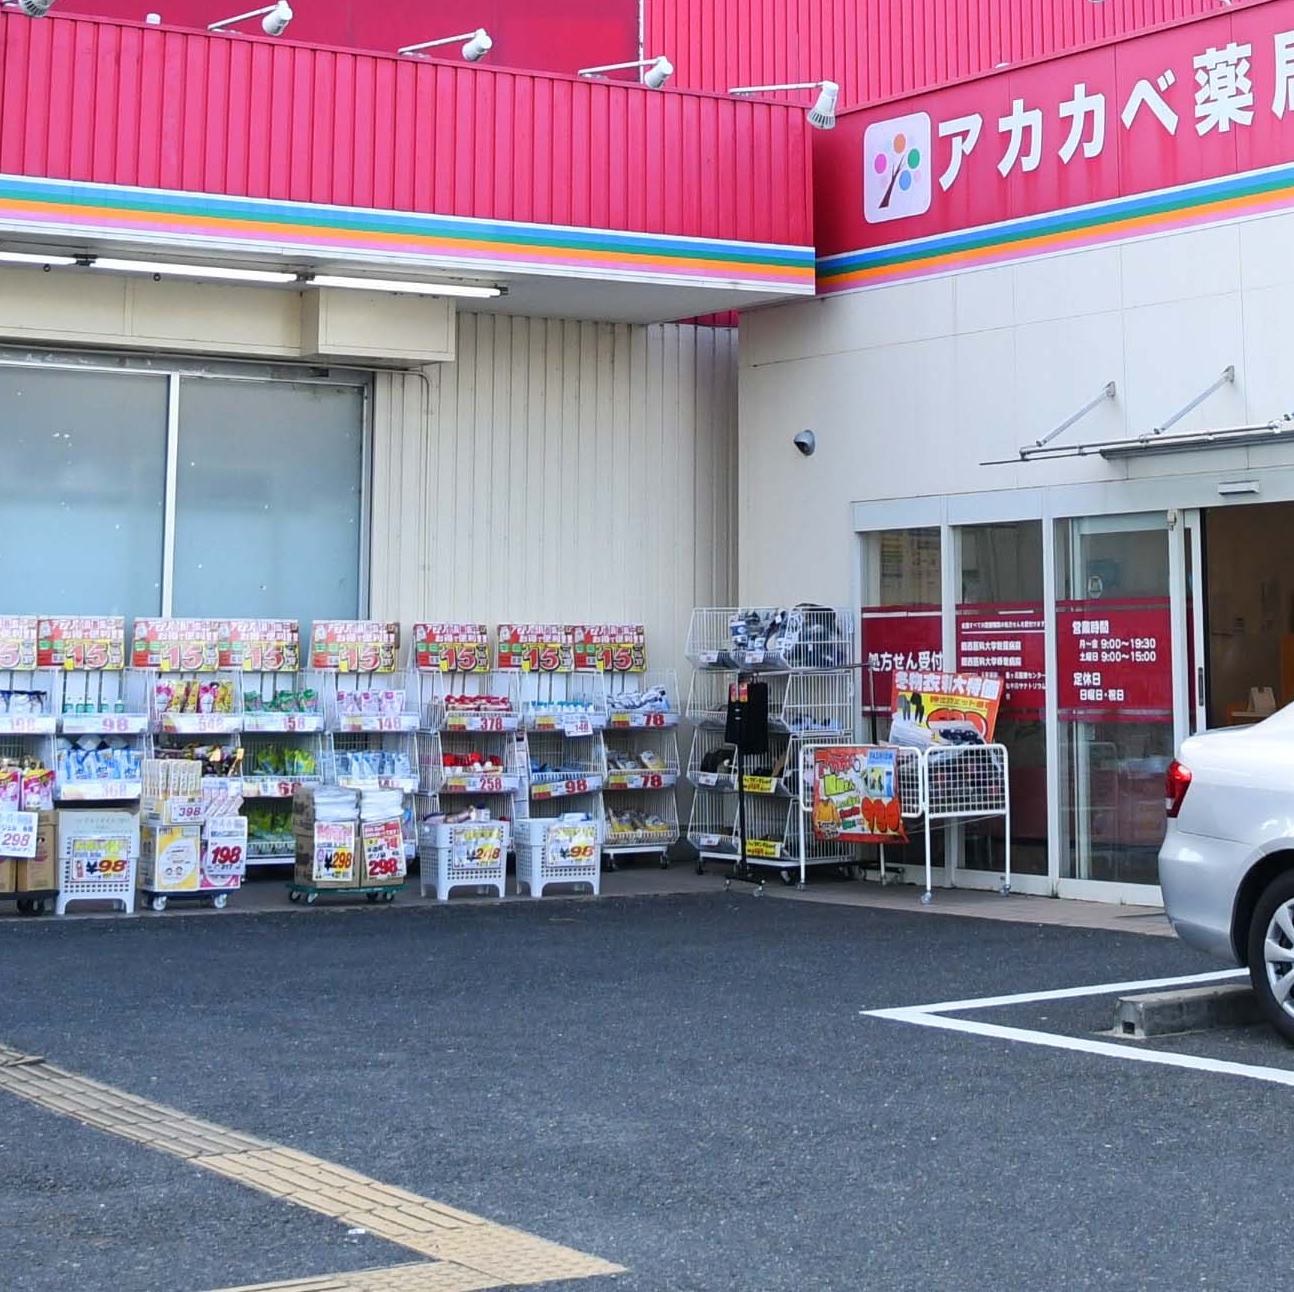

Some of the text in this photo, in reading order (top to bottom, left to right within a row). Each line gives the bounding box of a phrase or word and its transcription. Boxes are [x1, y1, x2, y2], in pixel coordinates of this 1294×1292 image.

[1072, 620, 1110, 635] 営業時間
[868, 651, 943, 673] 処方せん受付
[1073, 672, 1101, 686] 定休日
[480, 716, 503, 731] 378
[643, 713, 666, 727] 78
[479, 776, 503, 791] 258
[564, 779, 588, 794] 98
[640, 773, 663, 788] 78
[1, 832, 31, 847] 298
[211, 845, 243, 865] 198
[324, 851, 353, 872] ¥298
[85, 859, 128, 875] ¥98
[368, 857, 399, 876] 298
